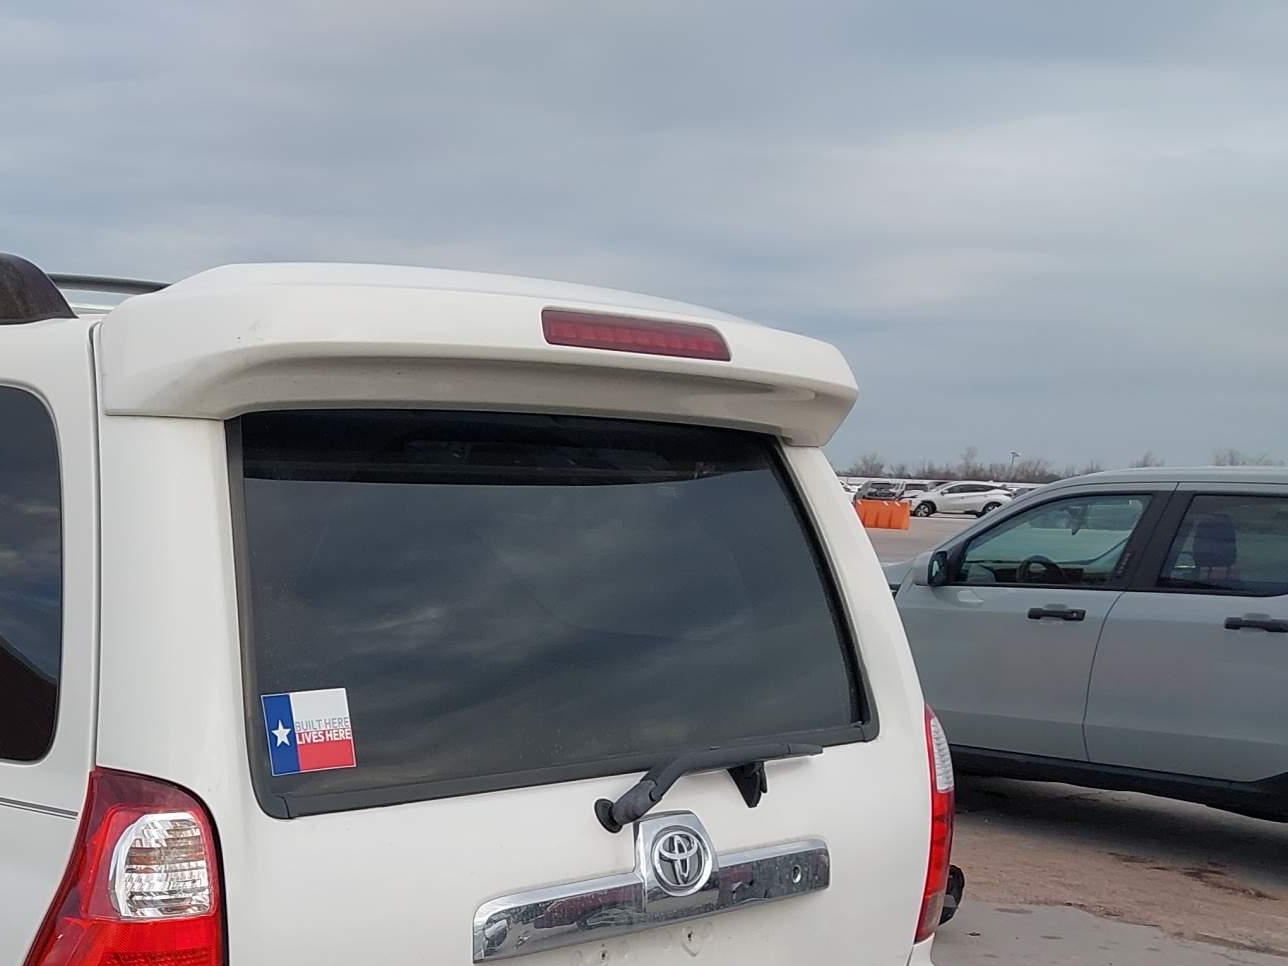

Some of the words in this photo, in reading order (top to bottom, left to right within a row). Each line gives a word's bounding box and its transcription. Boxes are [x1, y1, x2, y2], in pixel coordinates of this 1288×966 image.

[295, 719, 322, 731] BUILT
[324, 717, 349, 729] HERE
[296, 731, 324, 744] LIVES
[325, 728, 352, 741] HERE
